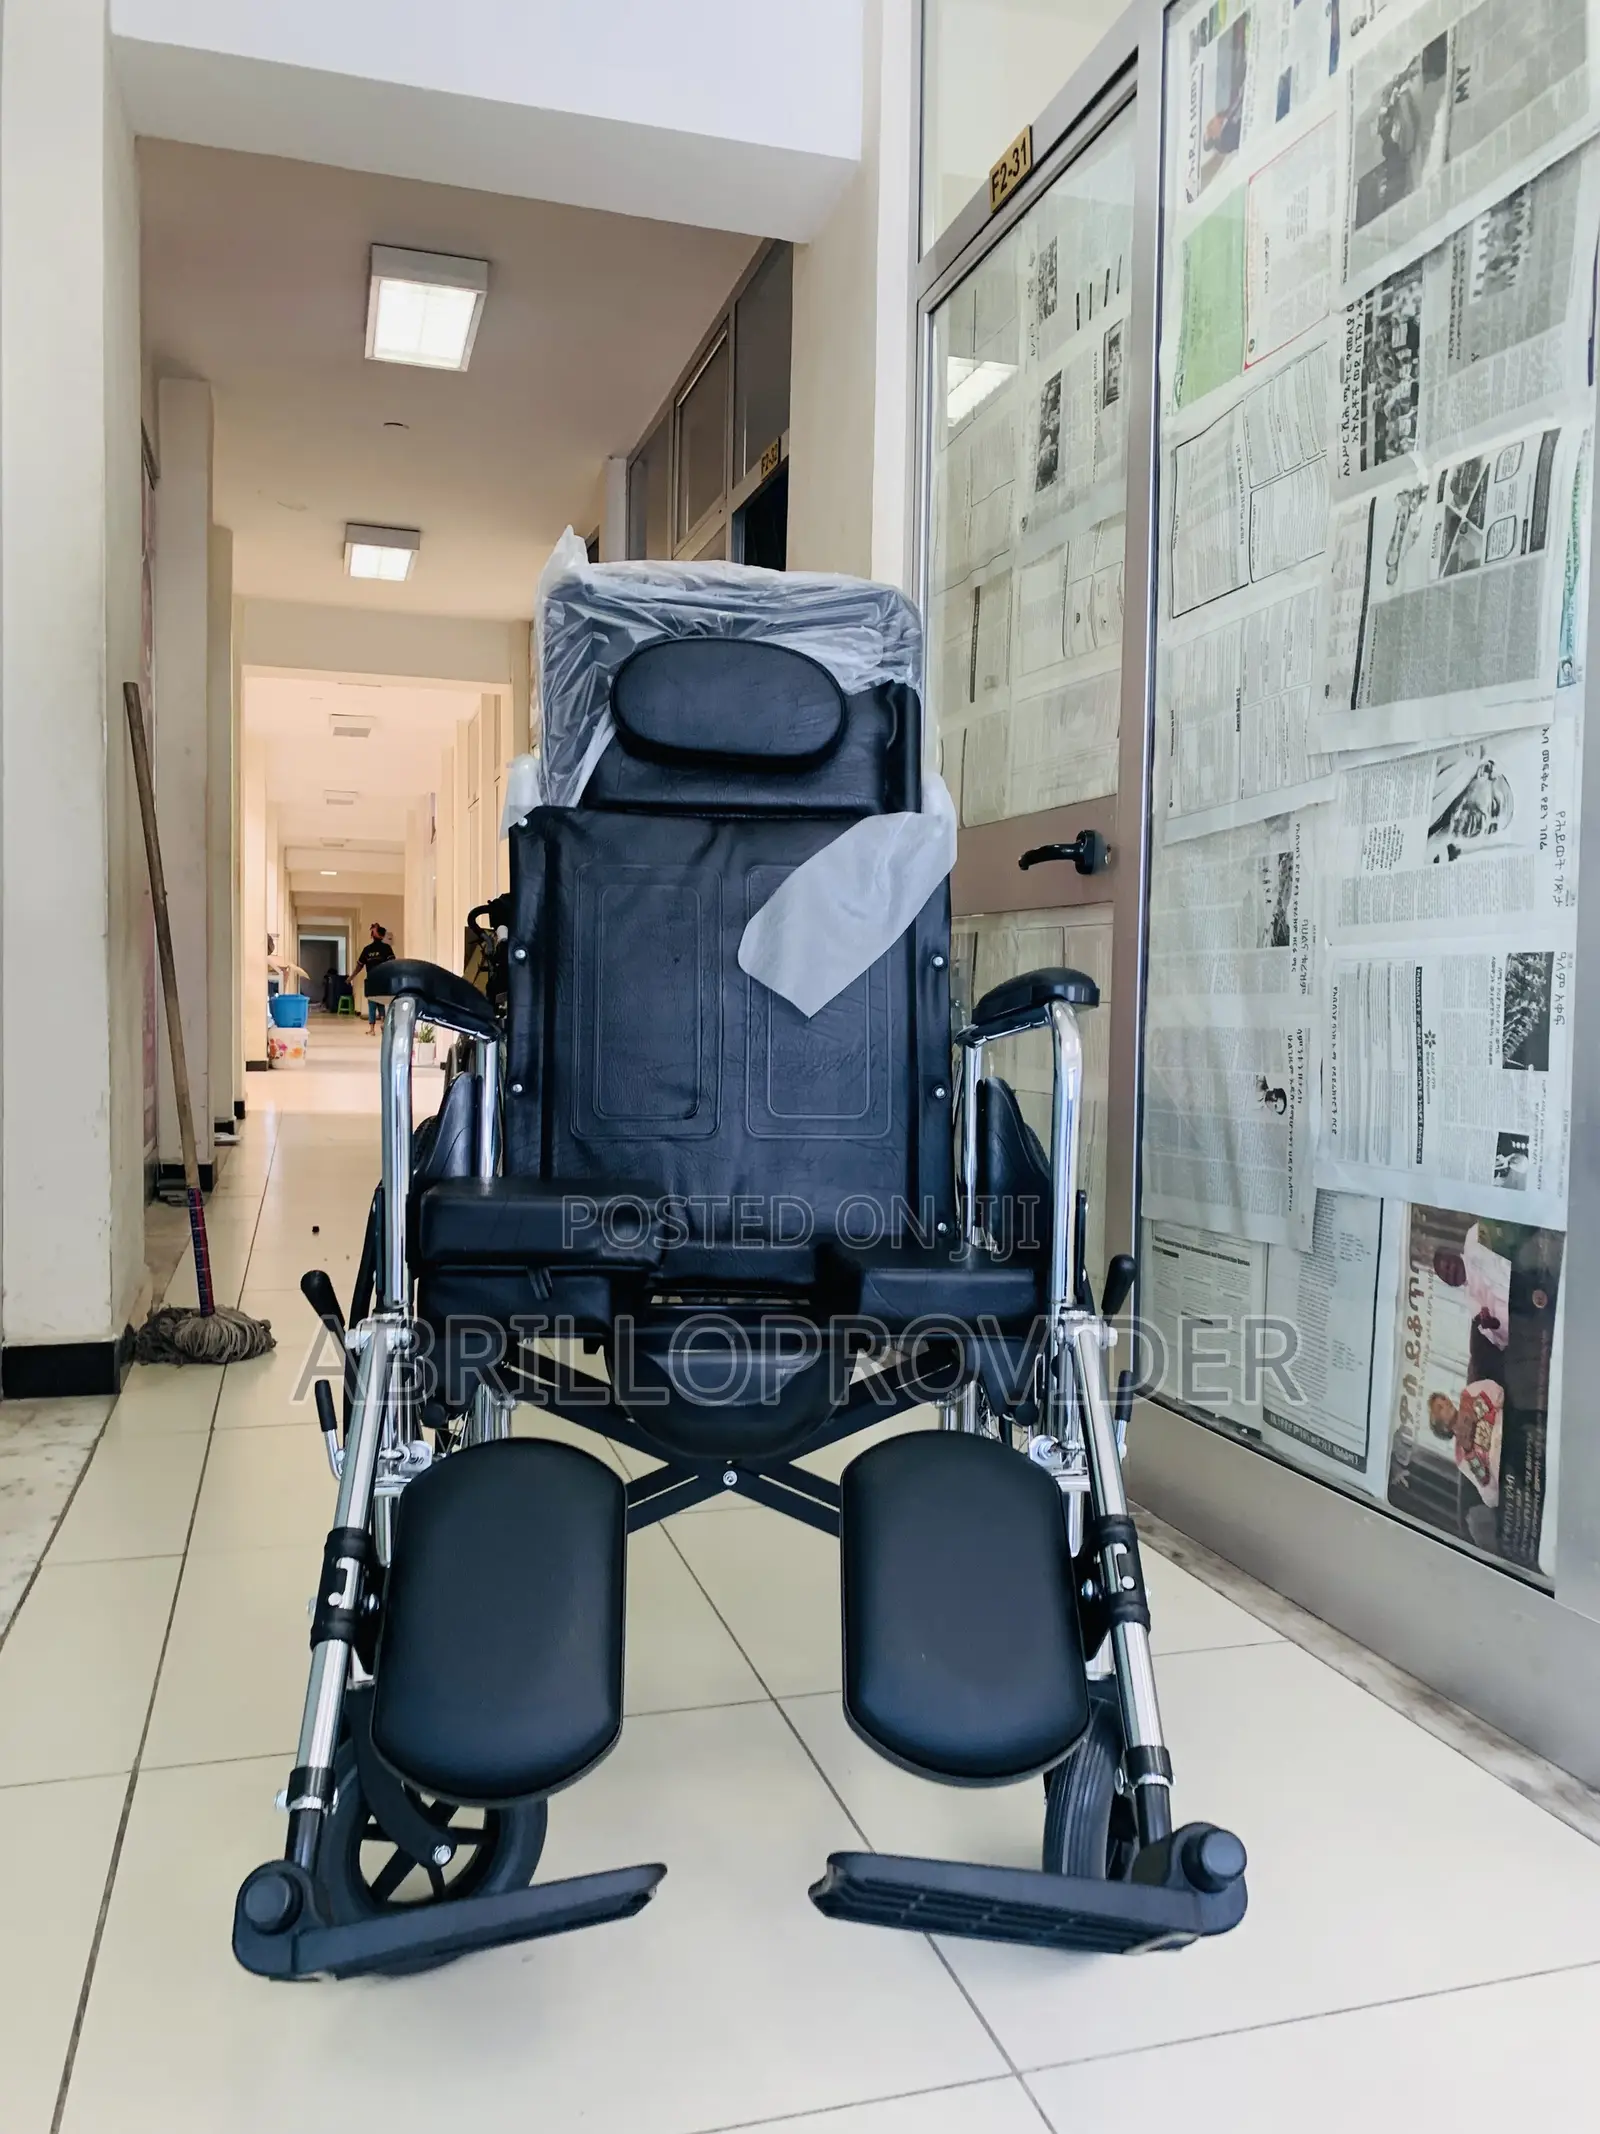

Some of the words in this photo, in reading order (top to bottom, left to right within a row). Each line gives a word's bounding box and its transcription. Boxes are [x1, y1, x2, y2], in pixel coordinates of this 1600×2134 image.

[1454, 65, 1470, 104] MY
[992, 137, 1026, 203] F2-31
[1353, 358, 1361, 380] ወደ
[1540, 797, 1548, 819] የደን
[1539, 825, 1548, 850] ገበሬ
[1554, 811, 1566, 870] የሕይወት
[1552, 876, 1565, 907] ገጽታ
[1300, 919, 1309, 951] ባህልና
[1556, 952, 1567, 988] ዓለም
[1554, 994, 1565, 1025] አቀፍ
